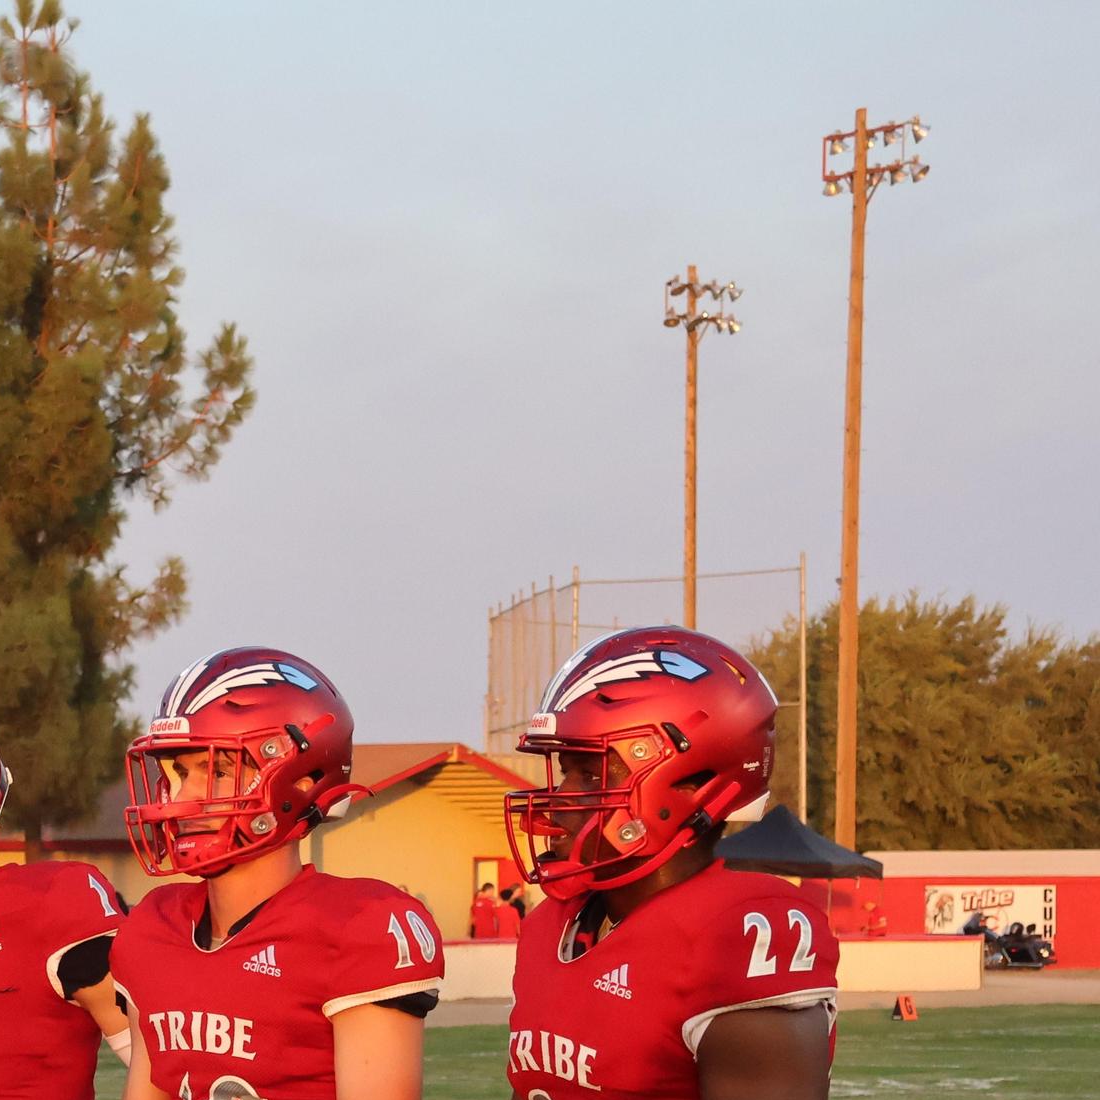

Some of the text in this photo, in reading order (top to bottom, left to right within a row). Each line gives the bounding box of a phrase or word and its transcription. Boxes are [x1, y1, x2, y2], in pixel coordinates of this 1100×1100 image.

[88, 873, 118, 917] 1
[387, 910, 437, 970] 10
[742, 909, 816, 979] 22
[242, 958, 282, 978] adidas
[593, 976, 633, 1001] adidas
[149, 1010, 257, 1061] TRIBE
[508, 1029, 602, 1092] TRIBE
